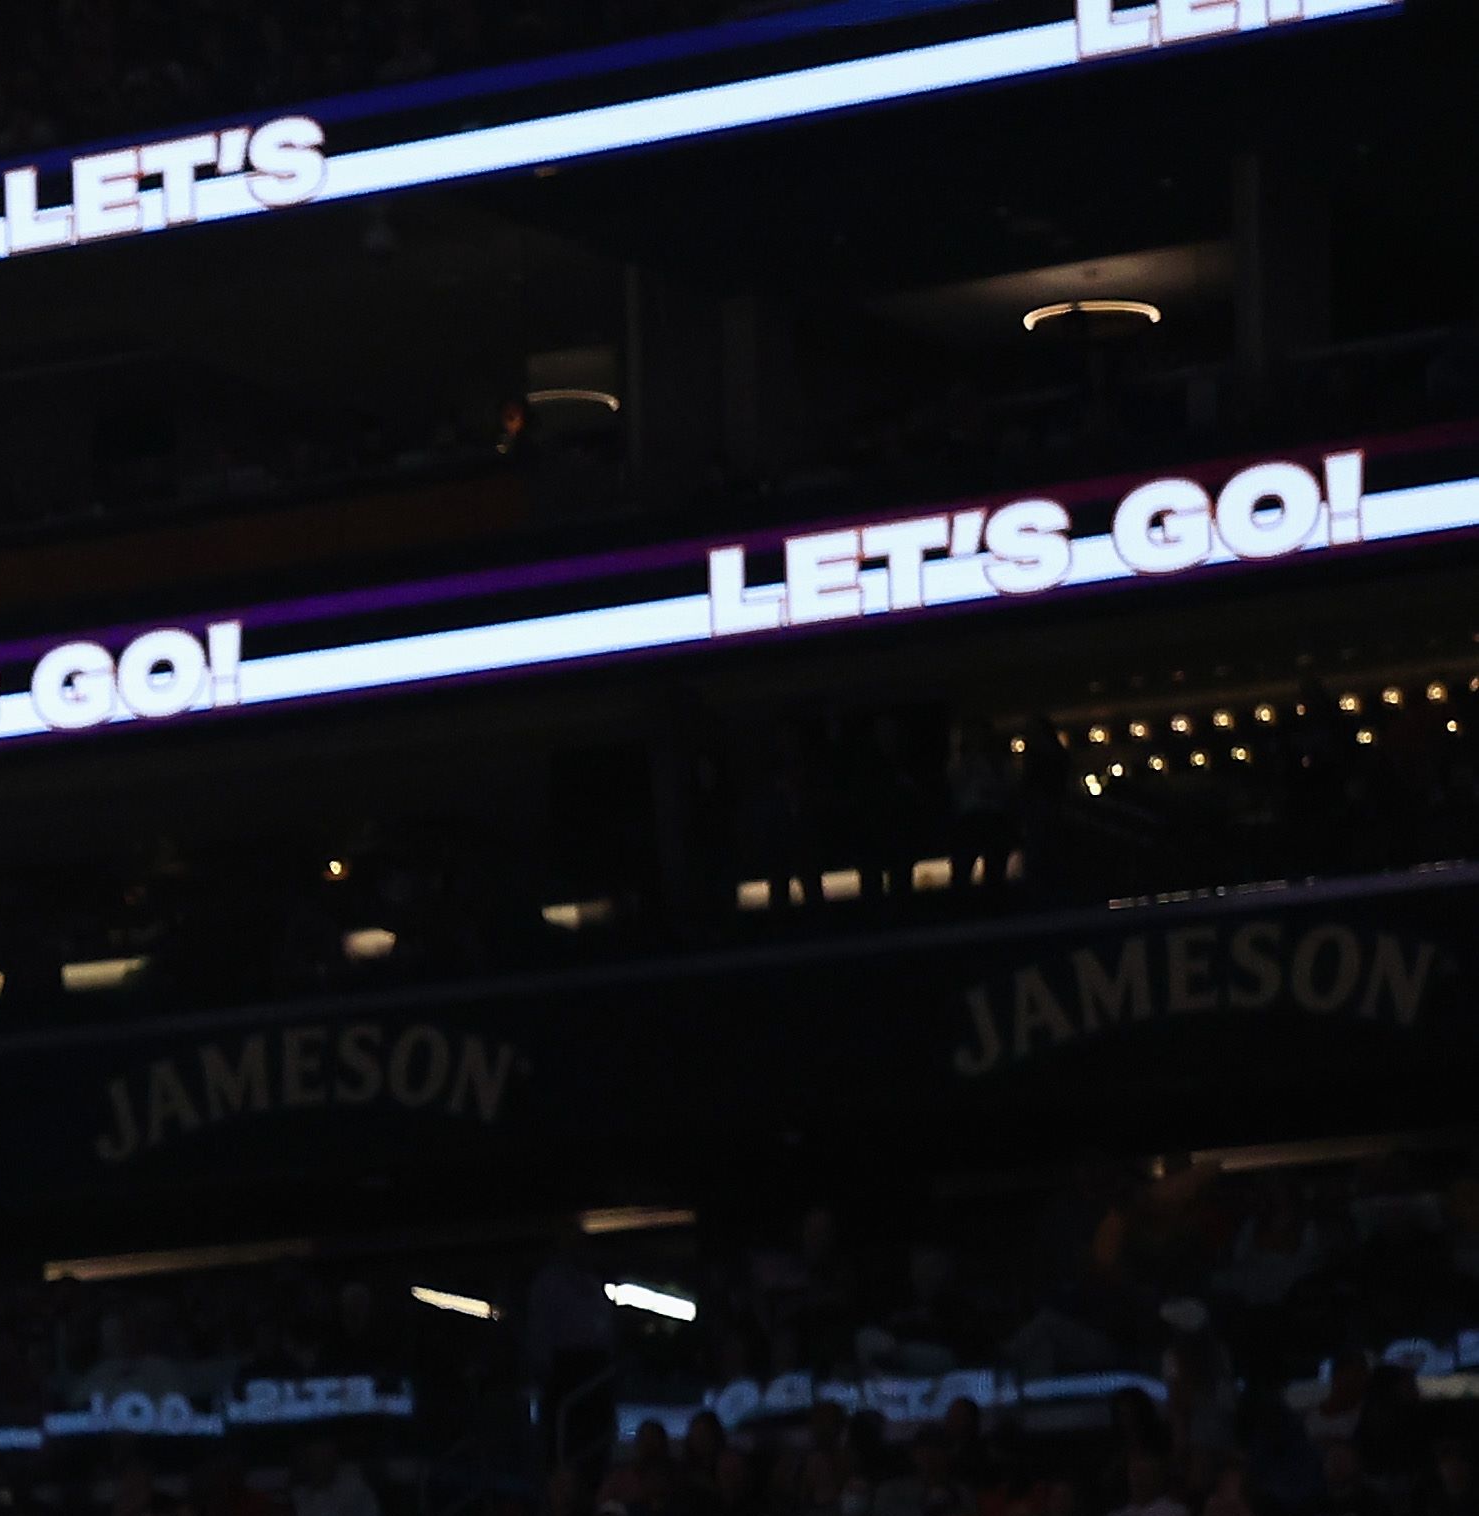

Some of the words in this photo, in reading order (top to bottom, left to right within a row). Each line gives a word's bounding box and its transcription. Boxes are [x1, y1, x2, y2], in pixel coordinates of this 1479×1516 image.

[4, 115, 327, 257] LET'S
[708, 499, 1071, 637] LET'S
[1113, 449, 1364, 576] GO!
[32, 619, 241, 729] GO!
[952, 921, 1436, 1076] JAMESON
[93, 1024, 518, 1163] JAMESON
